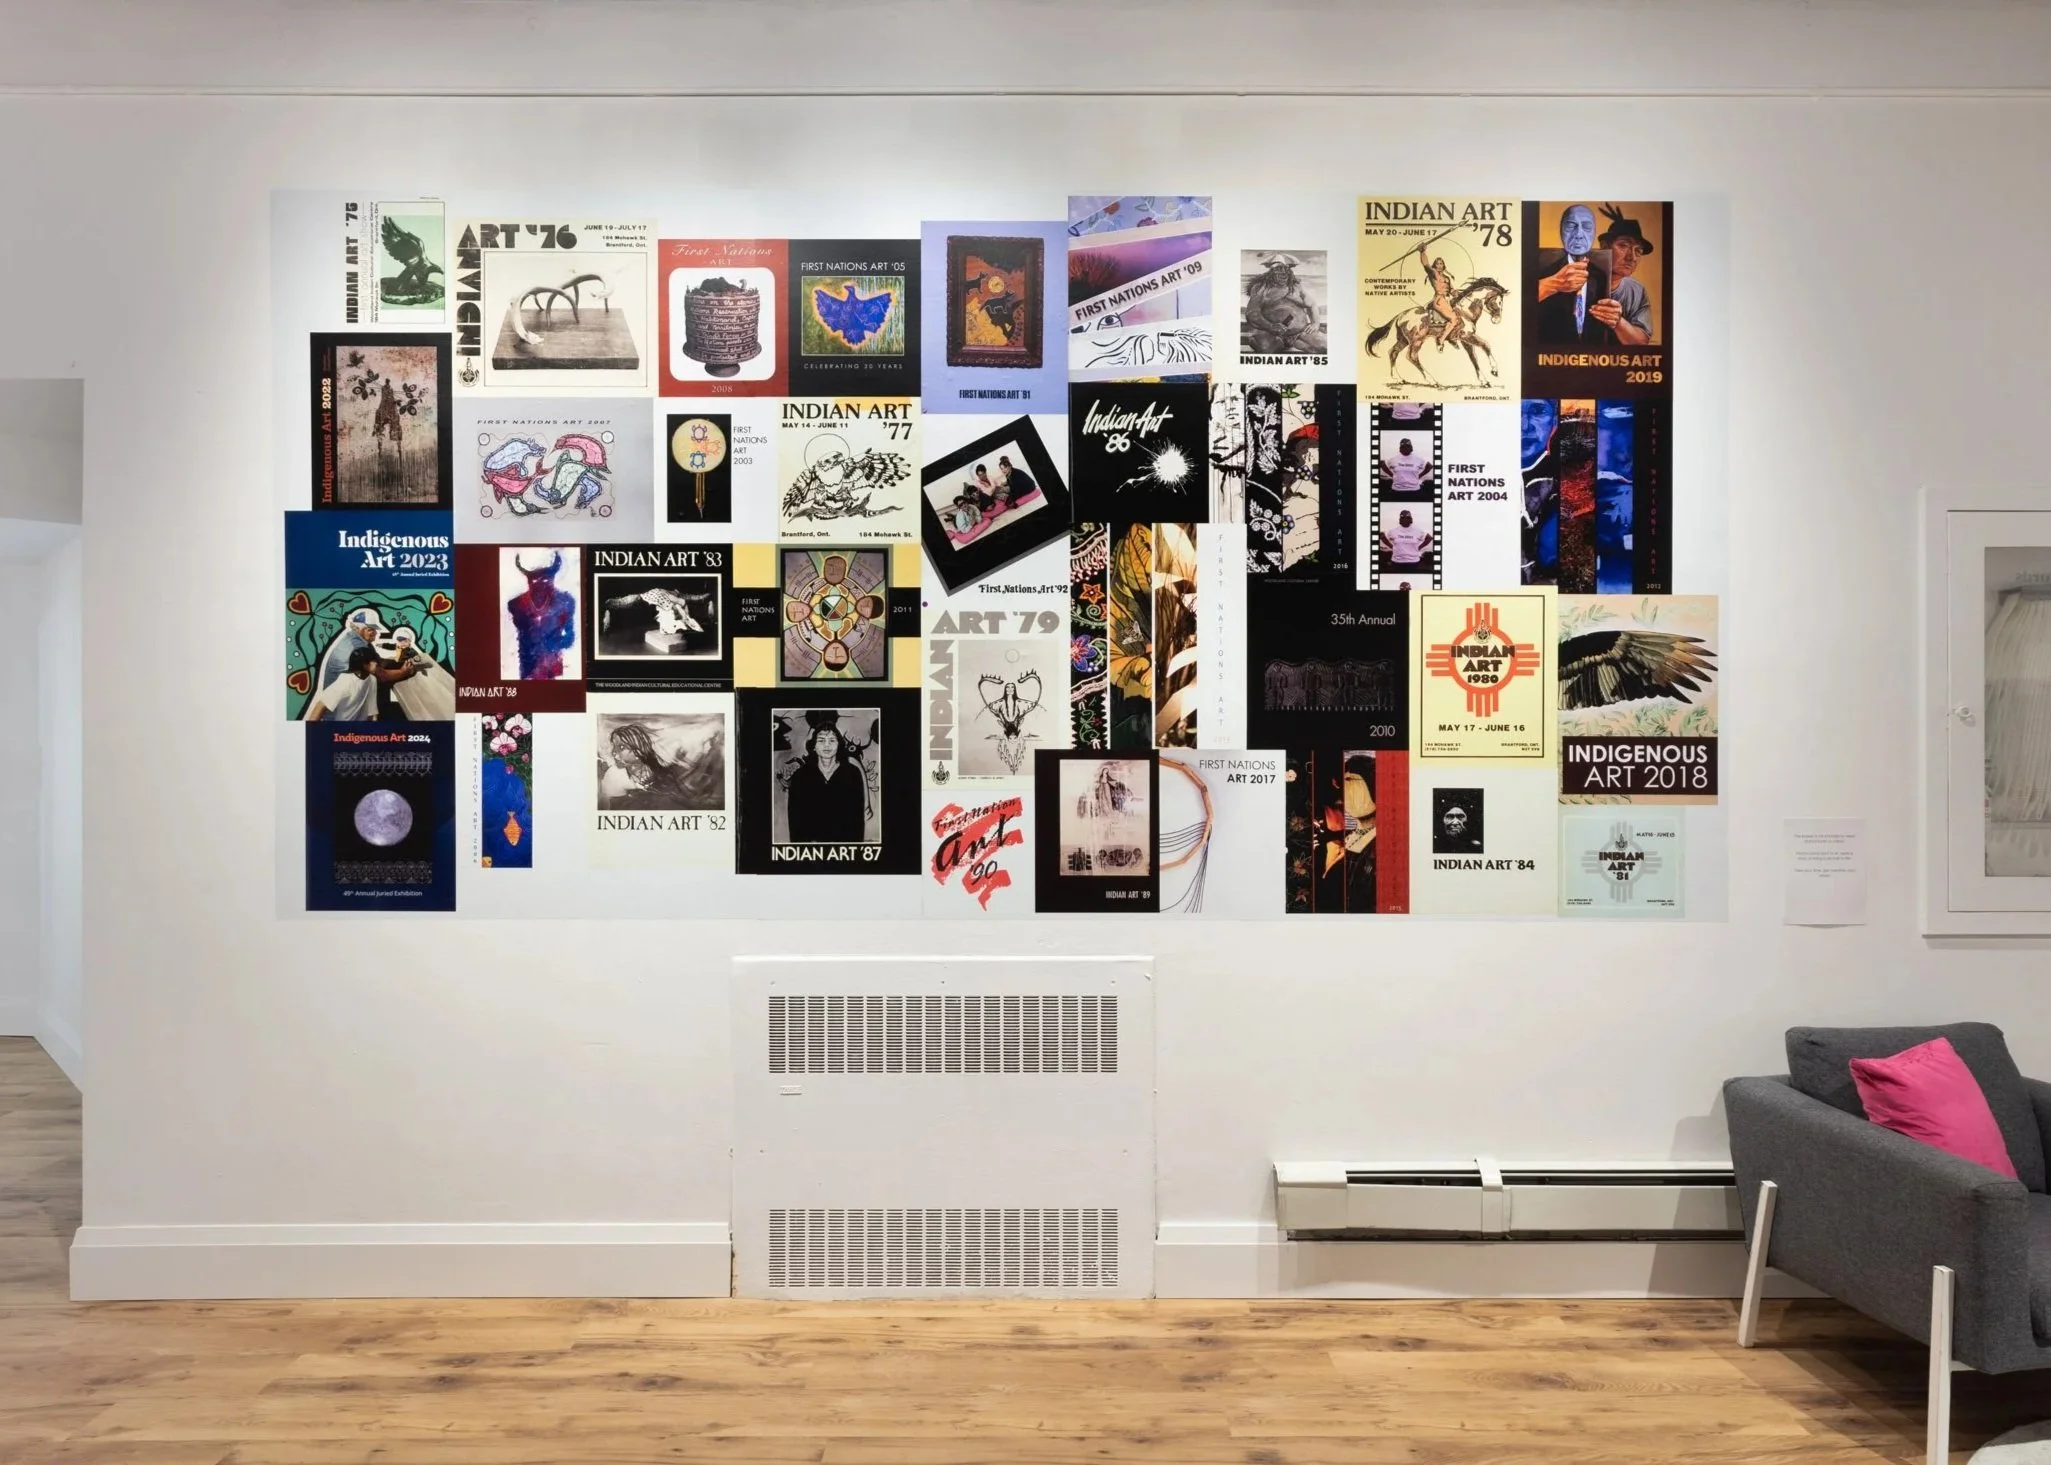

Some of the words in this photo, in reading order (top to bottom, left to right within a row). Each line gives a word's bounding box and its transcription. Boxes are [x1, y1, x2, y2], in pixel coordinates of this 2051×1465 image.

[345, 202, 358, 227] '75
[1365, 202, 1455, 221] INDIAN
[1462, 202, 1513, 221] ART
[457, 223, 520, 249] ART
[1365, 228, 1384, 236] MAY
[1386, 228, 1397, 236] 20
[1472, 222, 1513, 247] '78
[346, 236, 359, 265] ART
[672, 244, 711, 256] First
[714, 243, 773, 256] Nations
[801, 262, 824, 271] FIRST
[826, 262, 868, 271] NATIONS
[870, 262, 888, 271] ART
[346, 272, 359, 323] INDIAN
[1075, 299, 1107, 321] FIRST
[1108, 278, 1159, 307] NATIONS
[1161, 269, 1183, 287] ART
[456, 249, 482, 356] INDIAN
[1239, 355, 1283, 365] INDIAN
[1285, 356, 1308, 365] ART
[1310, 356, 1329, 366] '85
[1538, 354, 1629, 367] INDIGENOUS
[1631, 354, 1662, 367] ART
[1625, 371, 1663, 384] 2019
[321, 377, 332, 409] 2022
[711, 384, 733, 393] 2008
[959, 389, 978, 399] FIRST
[978, 389, 1006, 399] NATIONS
[1006, 389, 1020, 399] ART
[781, 403, 860, 420] INDIAN
[868, 403, 913, 420] ART
[321, 413, 332, 433] Art
[1081, 399, 1138, 435] Indian
[1134, 401, 1174, 439] Art
[733, 436, 768, 444] NATIONS
[733, 457, 753, 465] 2003
[322, 434, 335, 503] Indigenous
[1447, 464, 1486, 474] FIRST
[1447, 477, 1505, 487] NATIONS
[1447, 491, 1474, 501] ART
[1477, 491, 1508, 501] 2004
[338, 529, 450, 553] Indigenous
[360, 550, 396, 569] Art
[400, 553, 449, 571] 2023
[594, 551, 661, 567] INDIAN
[663, 551, 700, 567] ART
[978, 584, 1001, 593] First
[1001, 584, 1037, 594] Nations
[1037, 584, 1054, 594] Art
[741, 606, 775, 614] NATIONS
[930, 609, 1008, 634] ART
[1331, 612, 1356, 625] 35th
[1358, 612, 1396, 625] Annual
[1450, 645, 1516, 658] INDIAN
[1462, 658, 1503, 672] ART
[1467, 674, 1499, 684] 1980
[458, 686, 486, 698] INDIAN
[487, 686, 504, 698] ART
[928, 639, 955, 761] INDIAN
[1369, 724, 1396, 737] 2010
[1438, 724, 1461, 732] MAY
[1464, 724, 1476, 732] 17
[1484, 724, 1510, 732] JUNE
[1513, 724, 1525, 732] 16
[333, 732, 389, 744] Indigenous
[390, 733, 406, 742] Art
[407, 734, 431, 744] 2024
[1568, 744, 1708, 763] INDIGENOUS
[1199, 759, 1225, 770] FIRST
[1228, 759, 1276, 771] NATIONS
[1226, 773, 1247, 784] ART
[1249, 774, 1276, 785] 2017
[1584, 765, 1636, 788] ART
[1644, 765, 1708, 789] 2018
[597, 815, 663, 830] INDIAN
[667, 815, 702, 830] ART
[771, 846, 824, 861] INDIAN
[826, 846, 858, 861] ART
[860, 846, 883, 861] '87
[1598, 851, 1645, 861] INDIAN
[1433, 859, 1483, 870] INDIAN
[1485, 859, 1513, 870] ART
[1607, 861, 1636, 871] ART
[1105, 890, 1127, 899] INDIAN
[1128, 890, 1139, 899] ART
